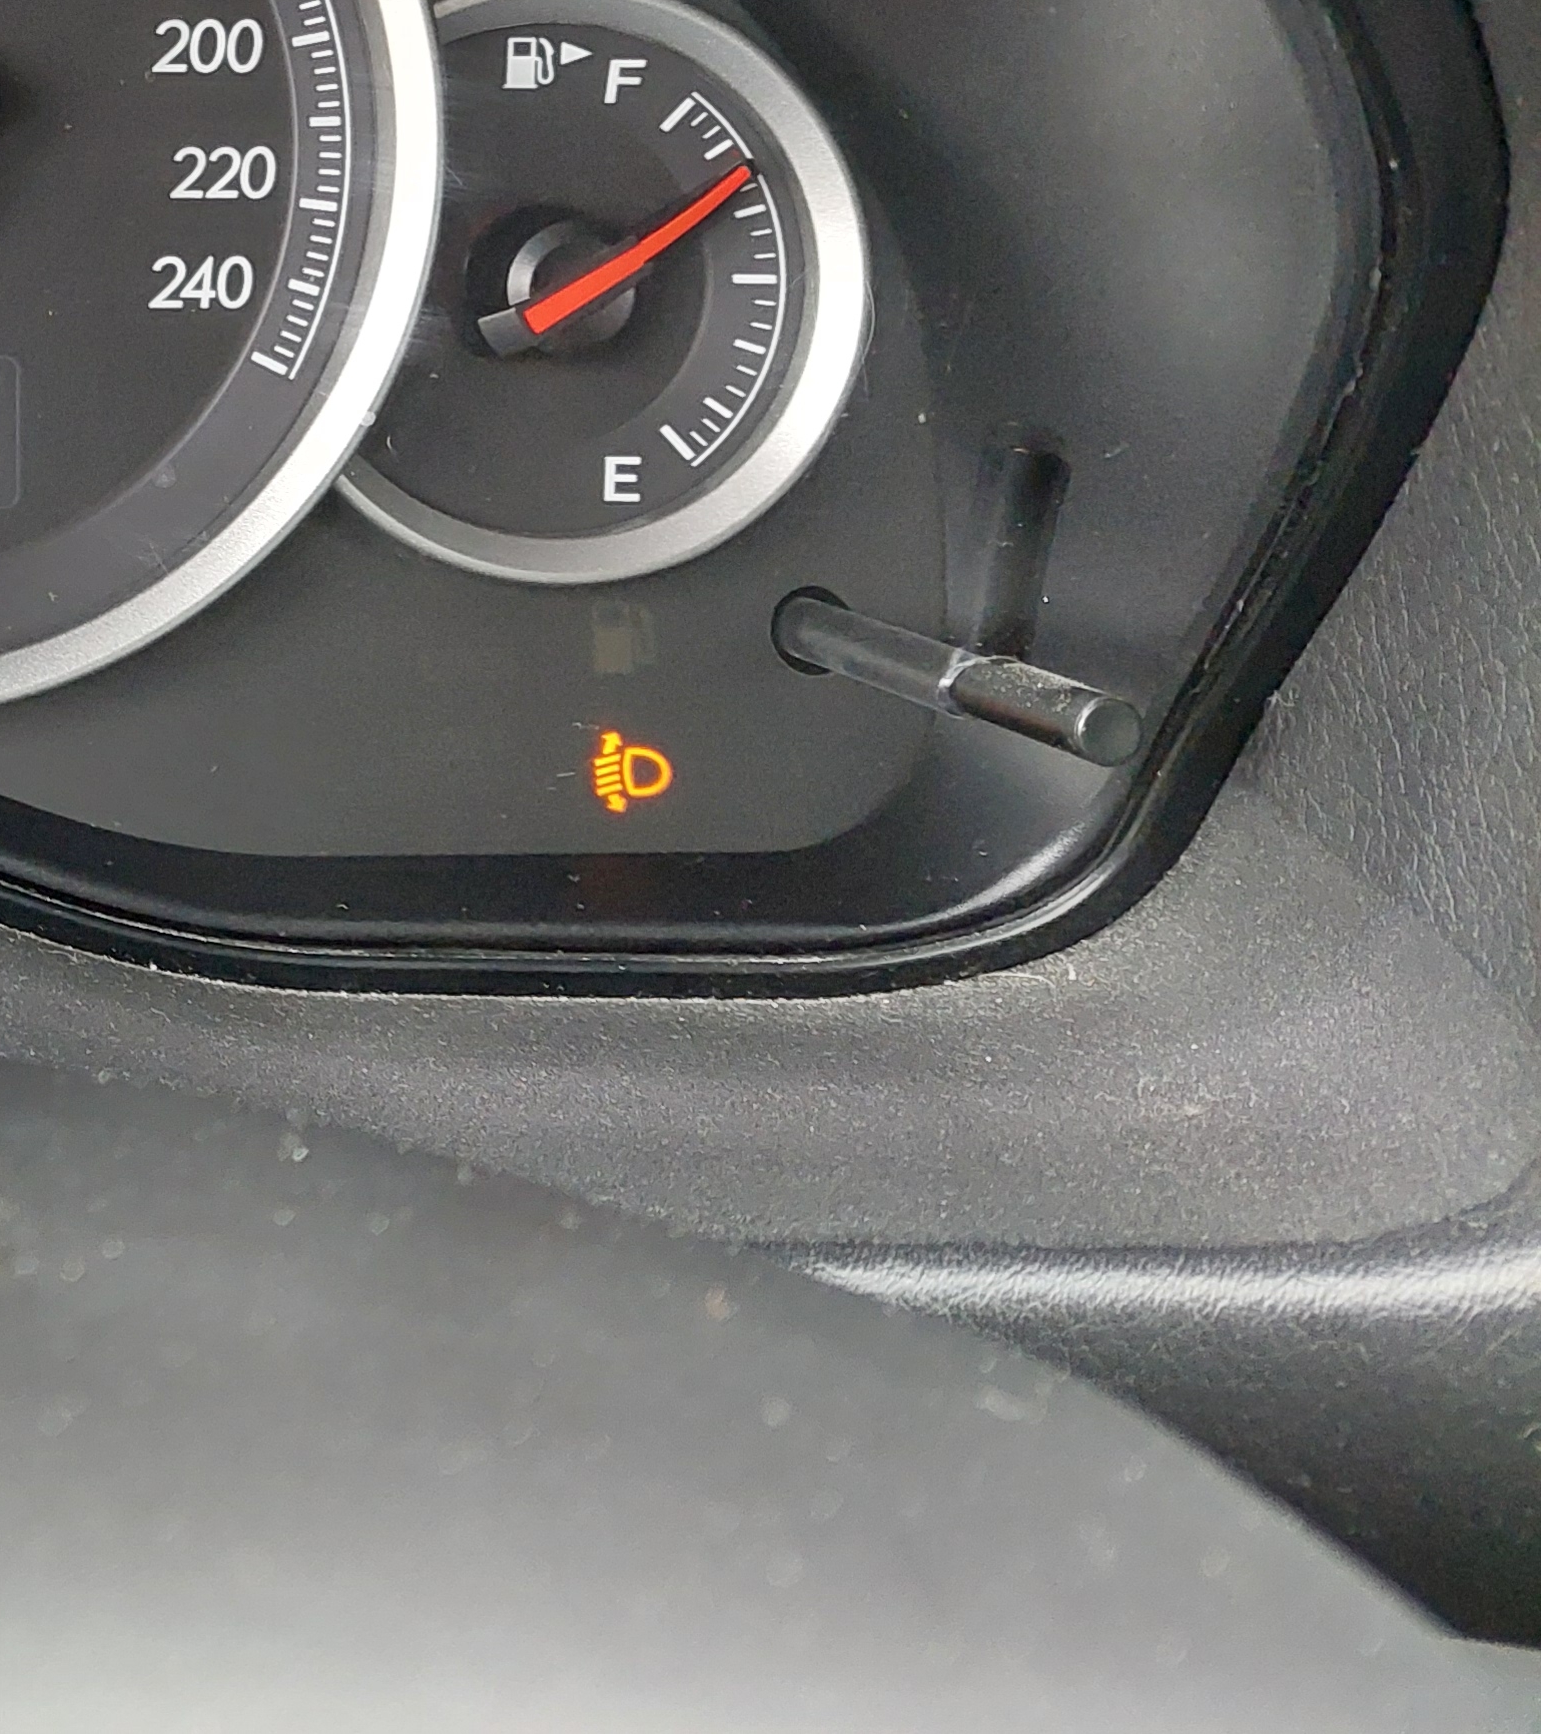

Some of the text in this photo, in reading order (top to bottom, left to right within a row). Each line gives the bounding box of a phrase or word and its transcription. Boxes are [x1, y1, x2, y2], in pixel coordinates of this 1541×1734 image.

[150, 17, 265, 75] 200
[602, 57, 649, 105] F
[168, 144, 278, 201] 220
[146, 253, 255, 311] 240
[602, 454, 644, 504] E
